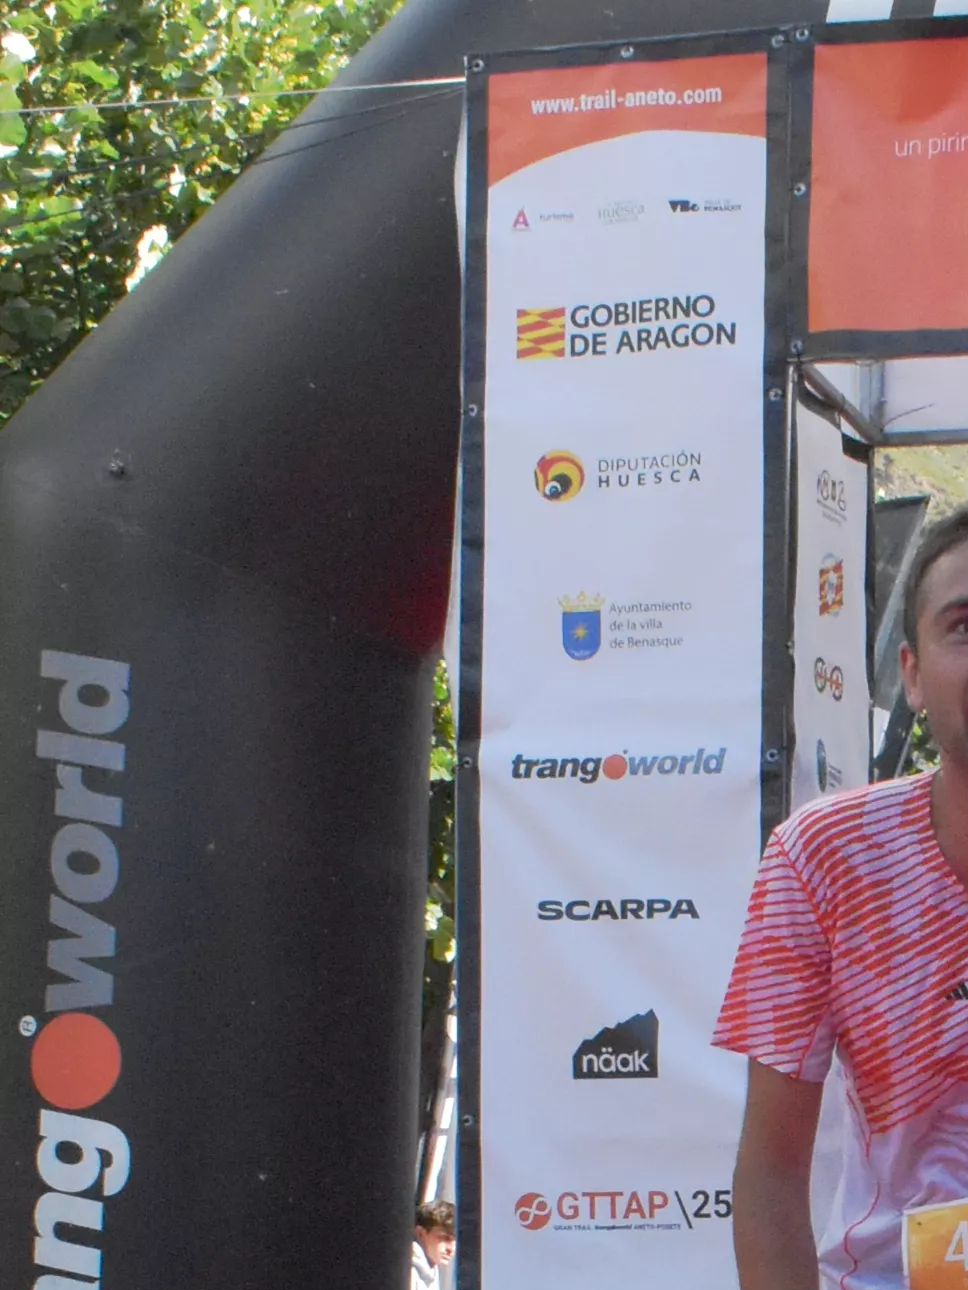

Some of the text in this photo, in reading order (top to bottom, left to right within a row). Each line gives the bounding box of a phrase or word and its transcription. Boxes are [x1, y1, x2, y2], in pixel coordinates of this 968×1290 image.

[531, 87, 722, 115] www.trail-aneto.com
[894, 139, 921, 157] un
[570, 295, 715, 329] GOBIERNO
[570, 322, 737, 357] DE ARAGON
[598, 450, 701, 473] DIPUTACIÓN
[598, 469, 701, 488] HUESCA
[609, 601, 692, 615] Ayuntamiento
[609, 618, 663, 631] de la villa
[609, 636, 683, 649] de Benasque
[511, 748, 727, 784] trangoworld
[537, 899, 700, 921] SCARPA
[582, 1047, 649, 1073] näak
[556, 1191, 669, 1220] GTTAP
